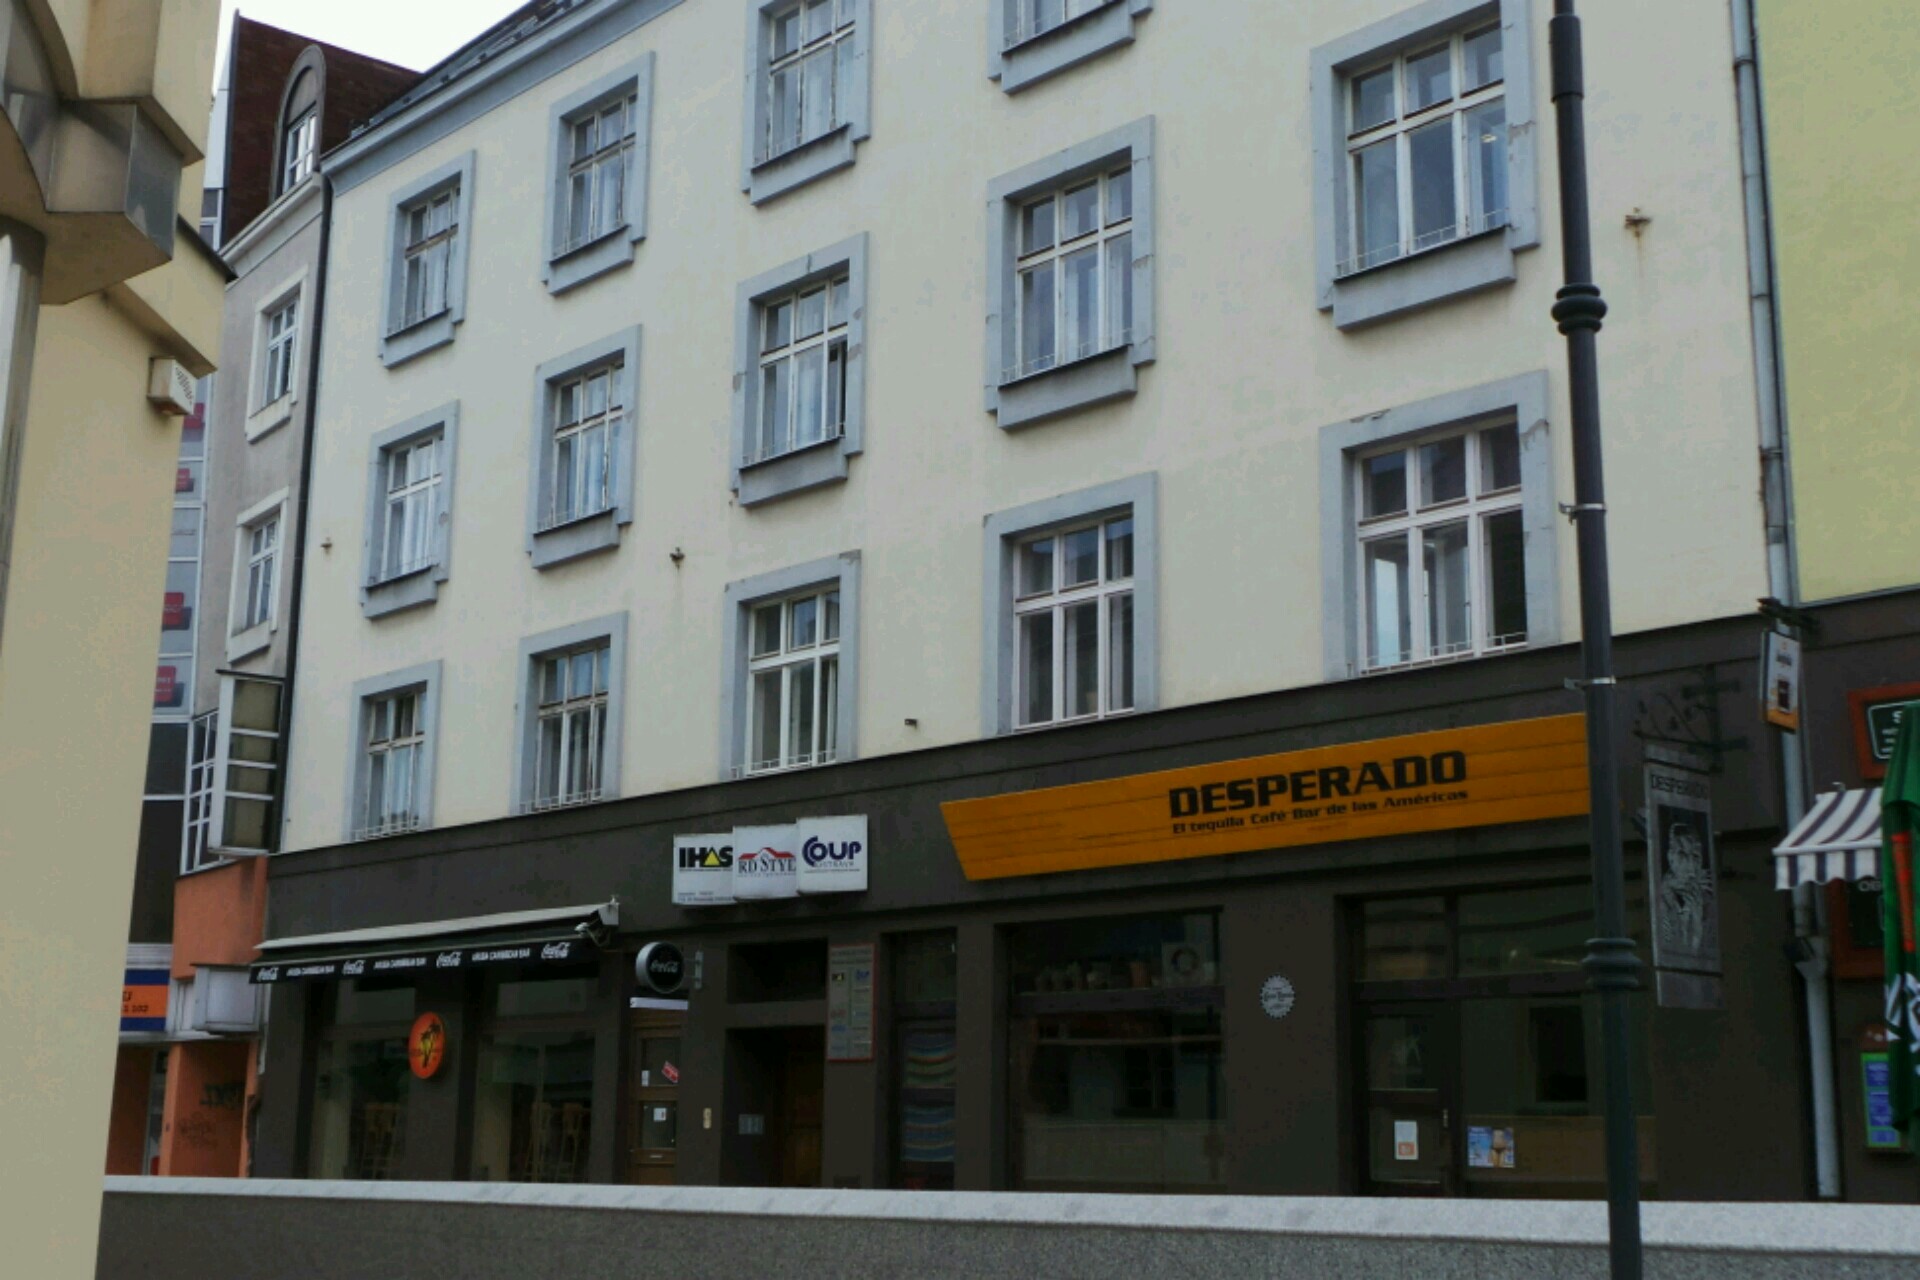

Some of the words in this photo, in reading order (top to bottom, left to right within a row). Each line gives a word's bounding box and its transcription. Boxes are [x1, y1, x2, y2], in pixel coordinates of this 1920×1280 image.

[1169, 751, 1467, 818] DESPERADO
[1173, 823, 1186, 834] El
[1191, 816, 1245, 831] tequila
[1251, 810, 1286, 824] Café
[1293, 807, 1321, 820] Bar
[1327, 803, 1346, 815] de
[1352, 801, 1378, 812] las
[1384, 791, 1468, 808] Américas
[680, 845, 734, 868] IHAS
[802, 836, 862, 867] COUP
